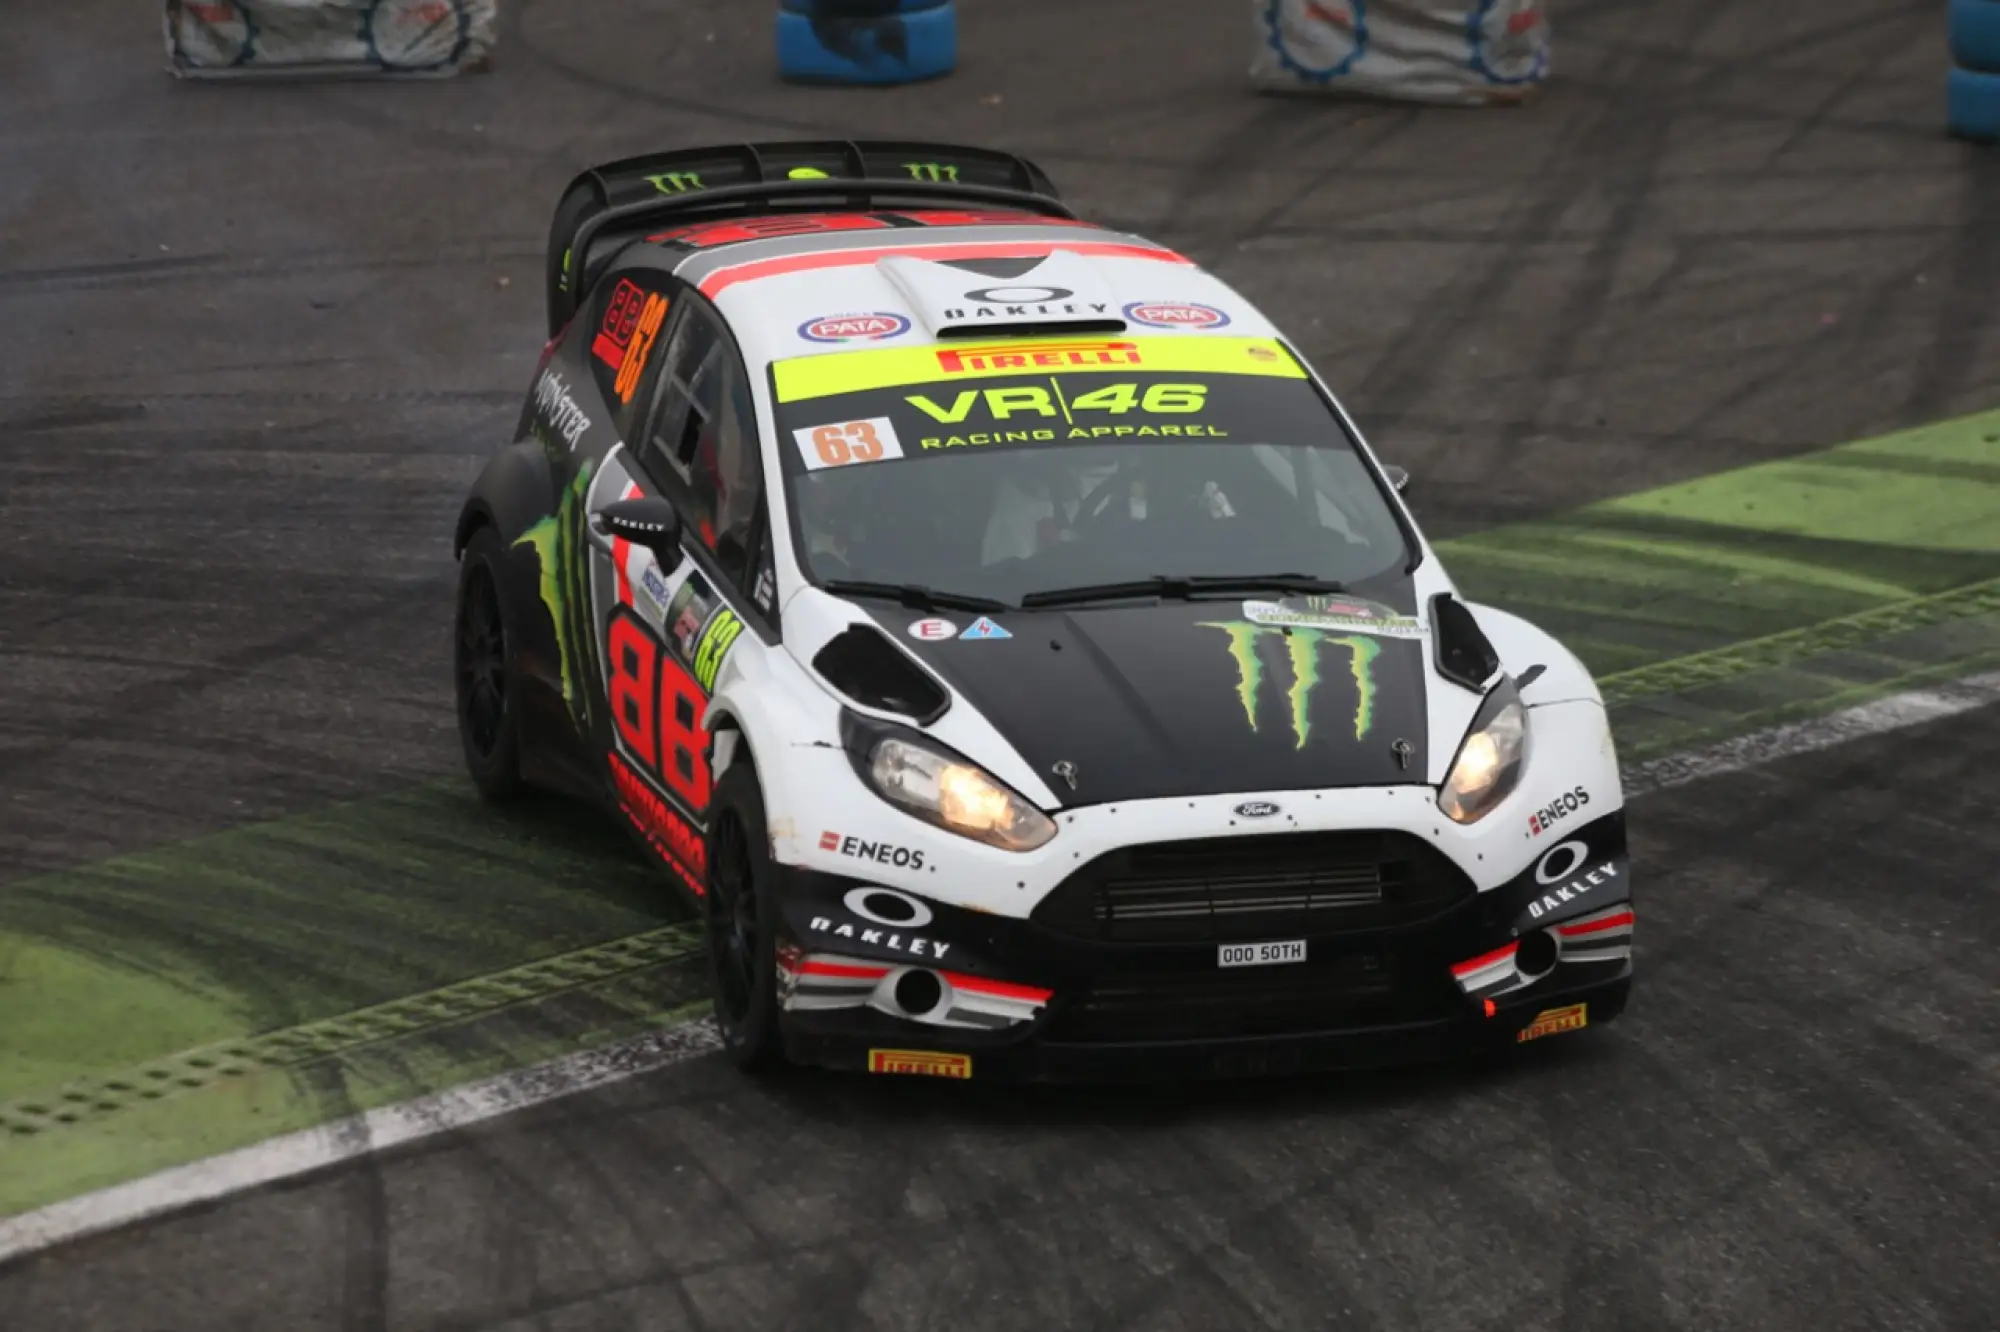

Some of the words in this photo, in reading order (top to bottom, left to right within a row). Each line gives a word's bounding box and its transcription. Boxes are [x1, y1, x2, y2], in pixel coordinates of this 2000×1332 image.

[819, 319, 887, 336] PATA
[943, 303, 1106, 320] OAKLEY
[936, 342, 1142, 373] PIRELLI
[812, 421, 884, 466] 63
[919, 430, 1055, 450] RACING
[1067, 424, 1229, 441] APPAREL
[920, 621, 943, 637] E
[1536, 784, 1590, 830] ENEOS
[840, 836, 925, 871] ENEOS
[1527, 861, 1618, 918] OAKLEY
[809, 916, 950, 960] OAKLEY
